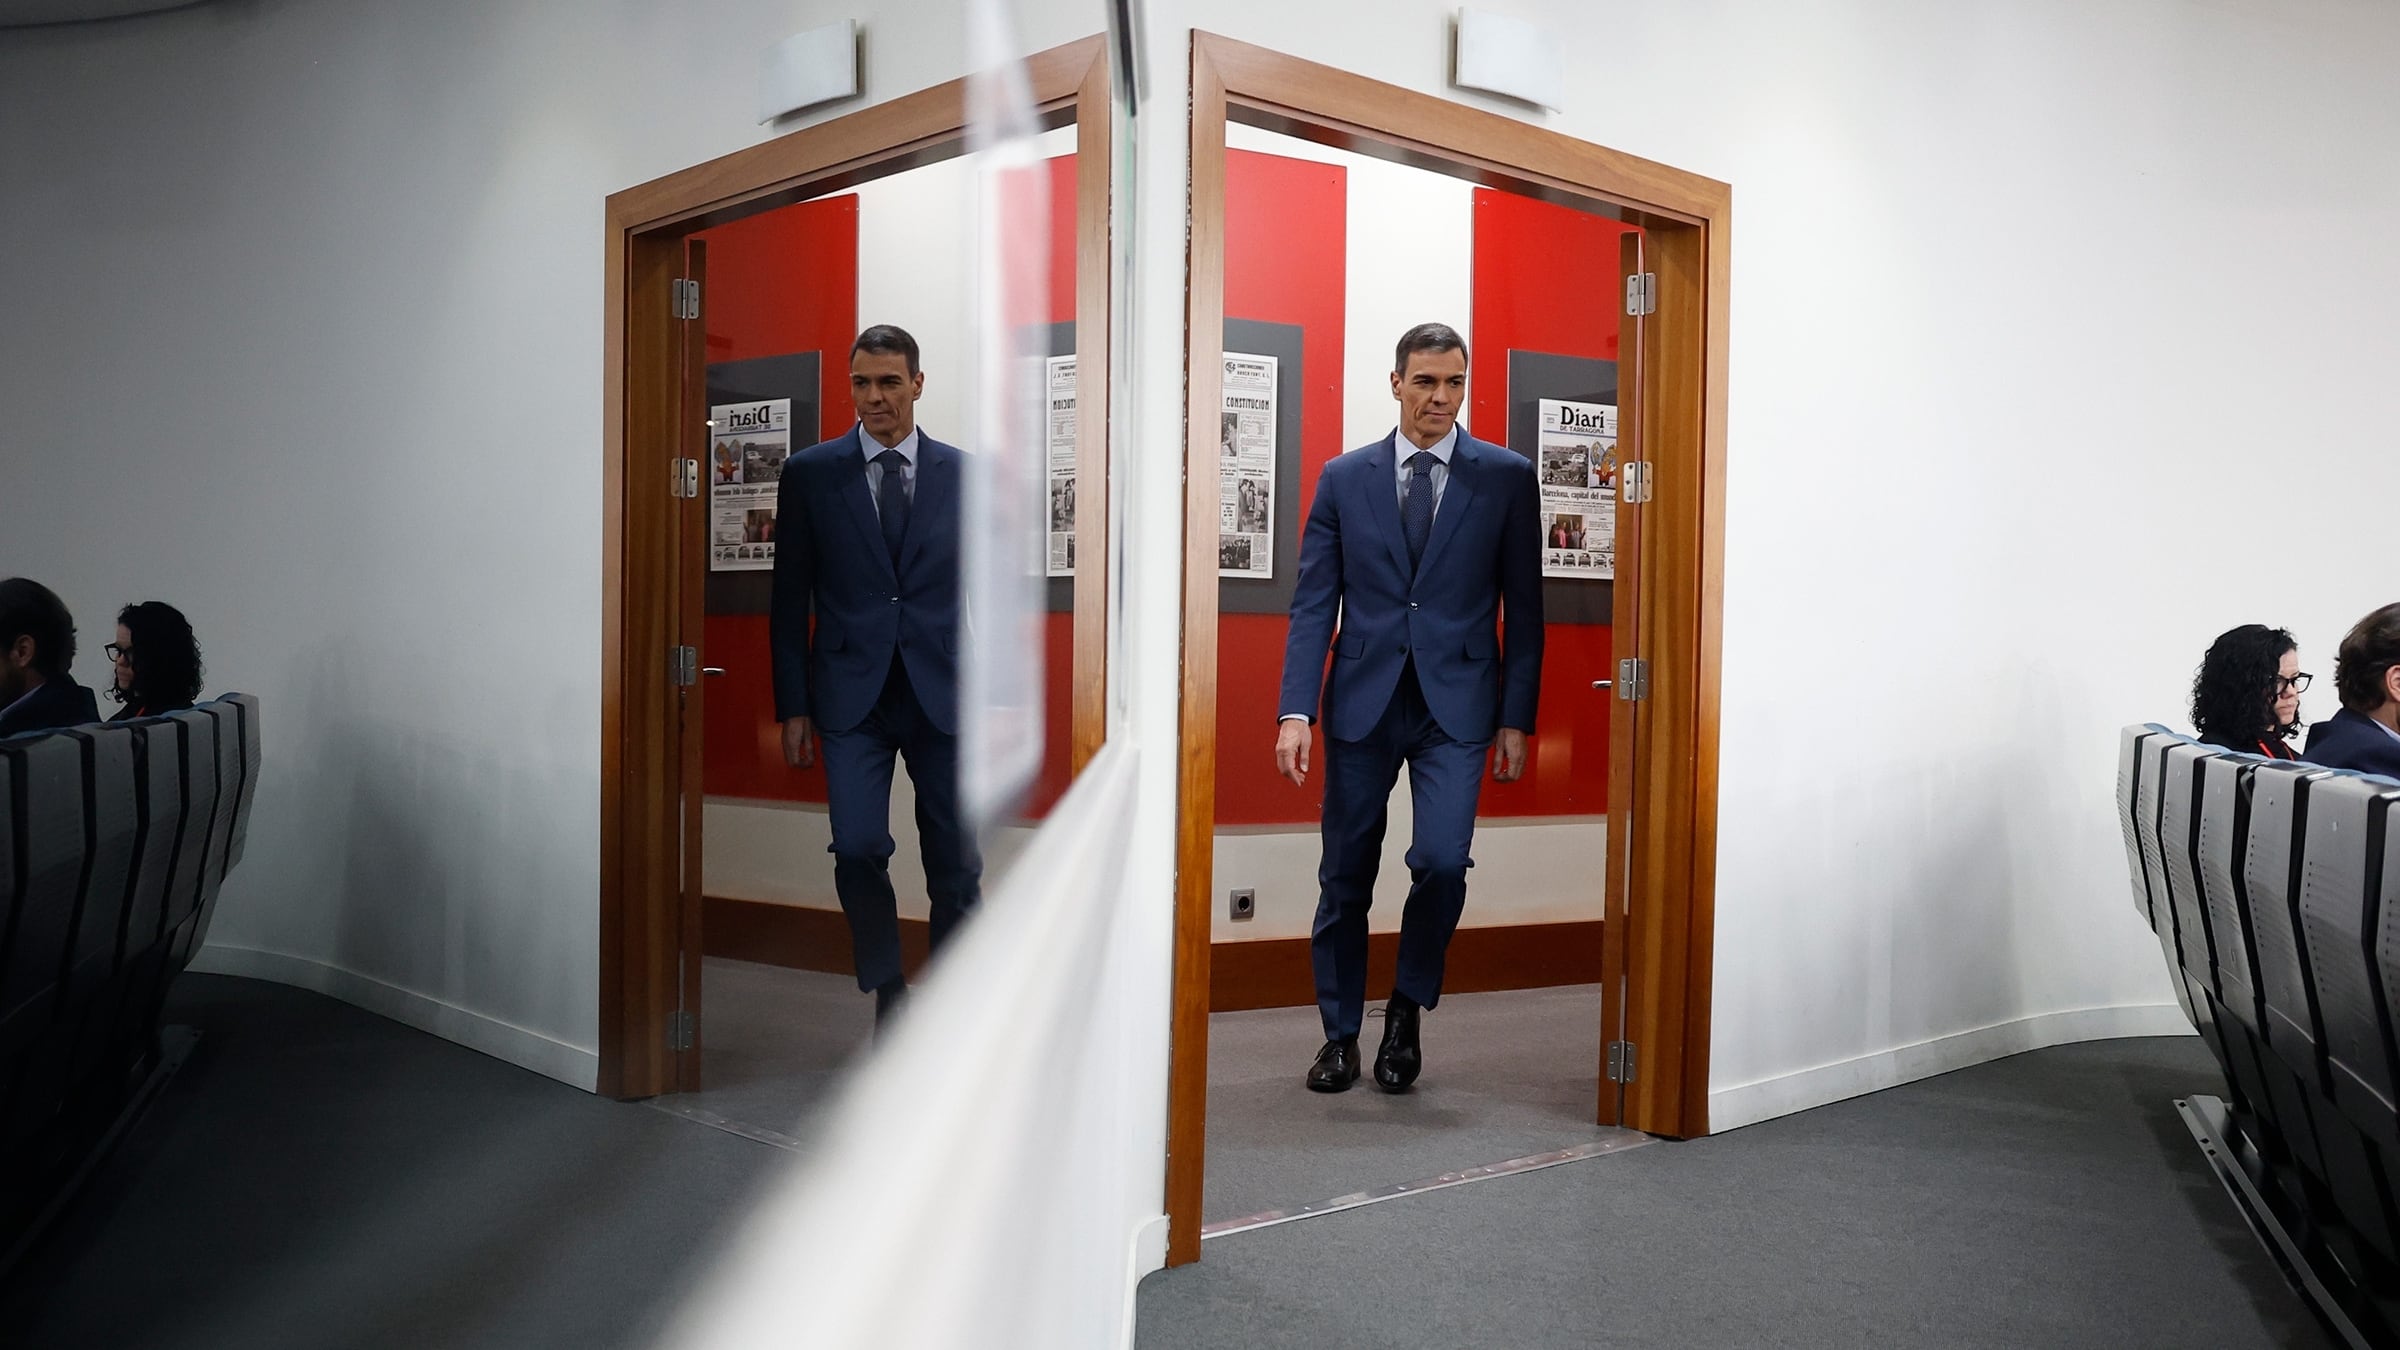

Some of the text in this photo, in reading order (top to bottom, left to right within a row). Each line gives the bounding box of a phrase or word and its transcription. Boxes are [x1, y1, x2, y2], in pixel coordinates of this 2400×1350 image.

[1226, 396, 1270, 410] CONSTITUCION
[1561, 406, 1604, 428] Diari
[1569, 426, 1604, 434] TARRAGONA
[1570, 491, 1589, 500] capital
